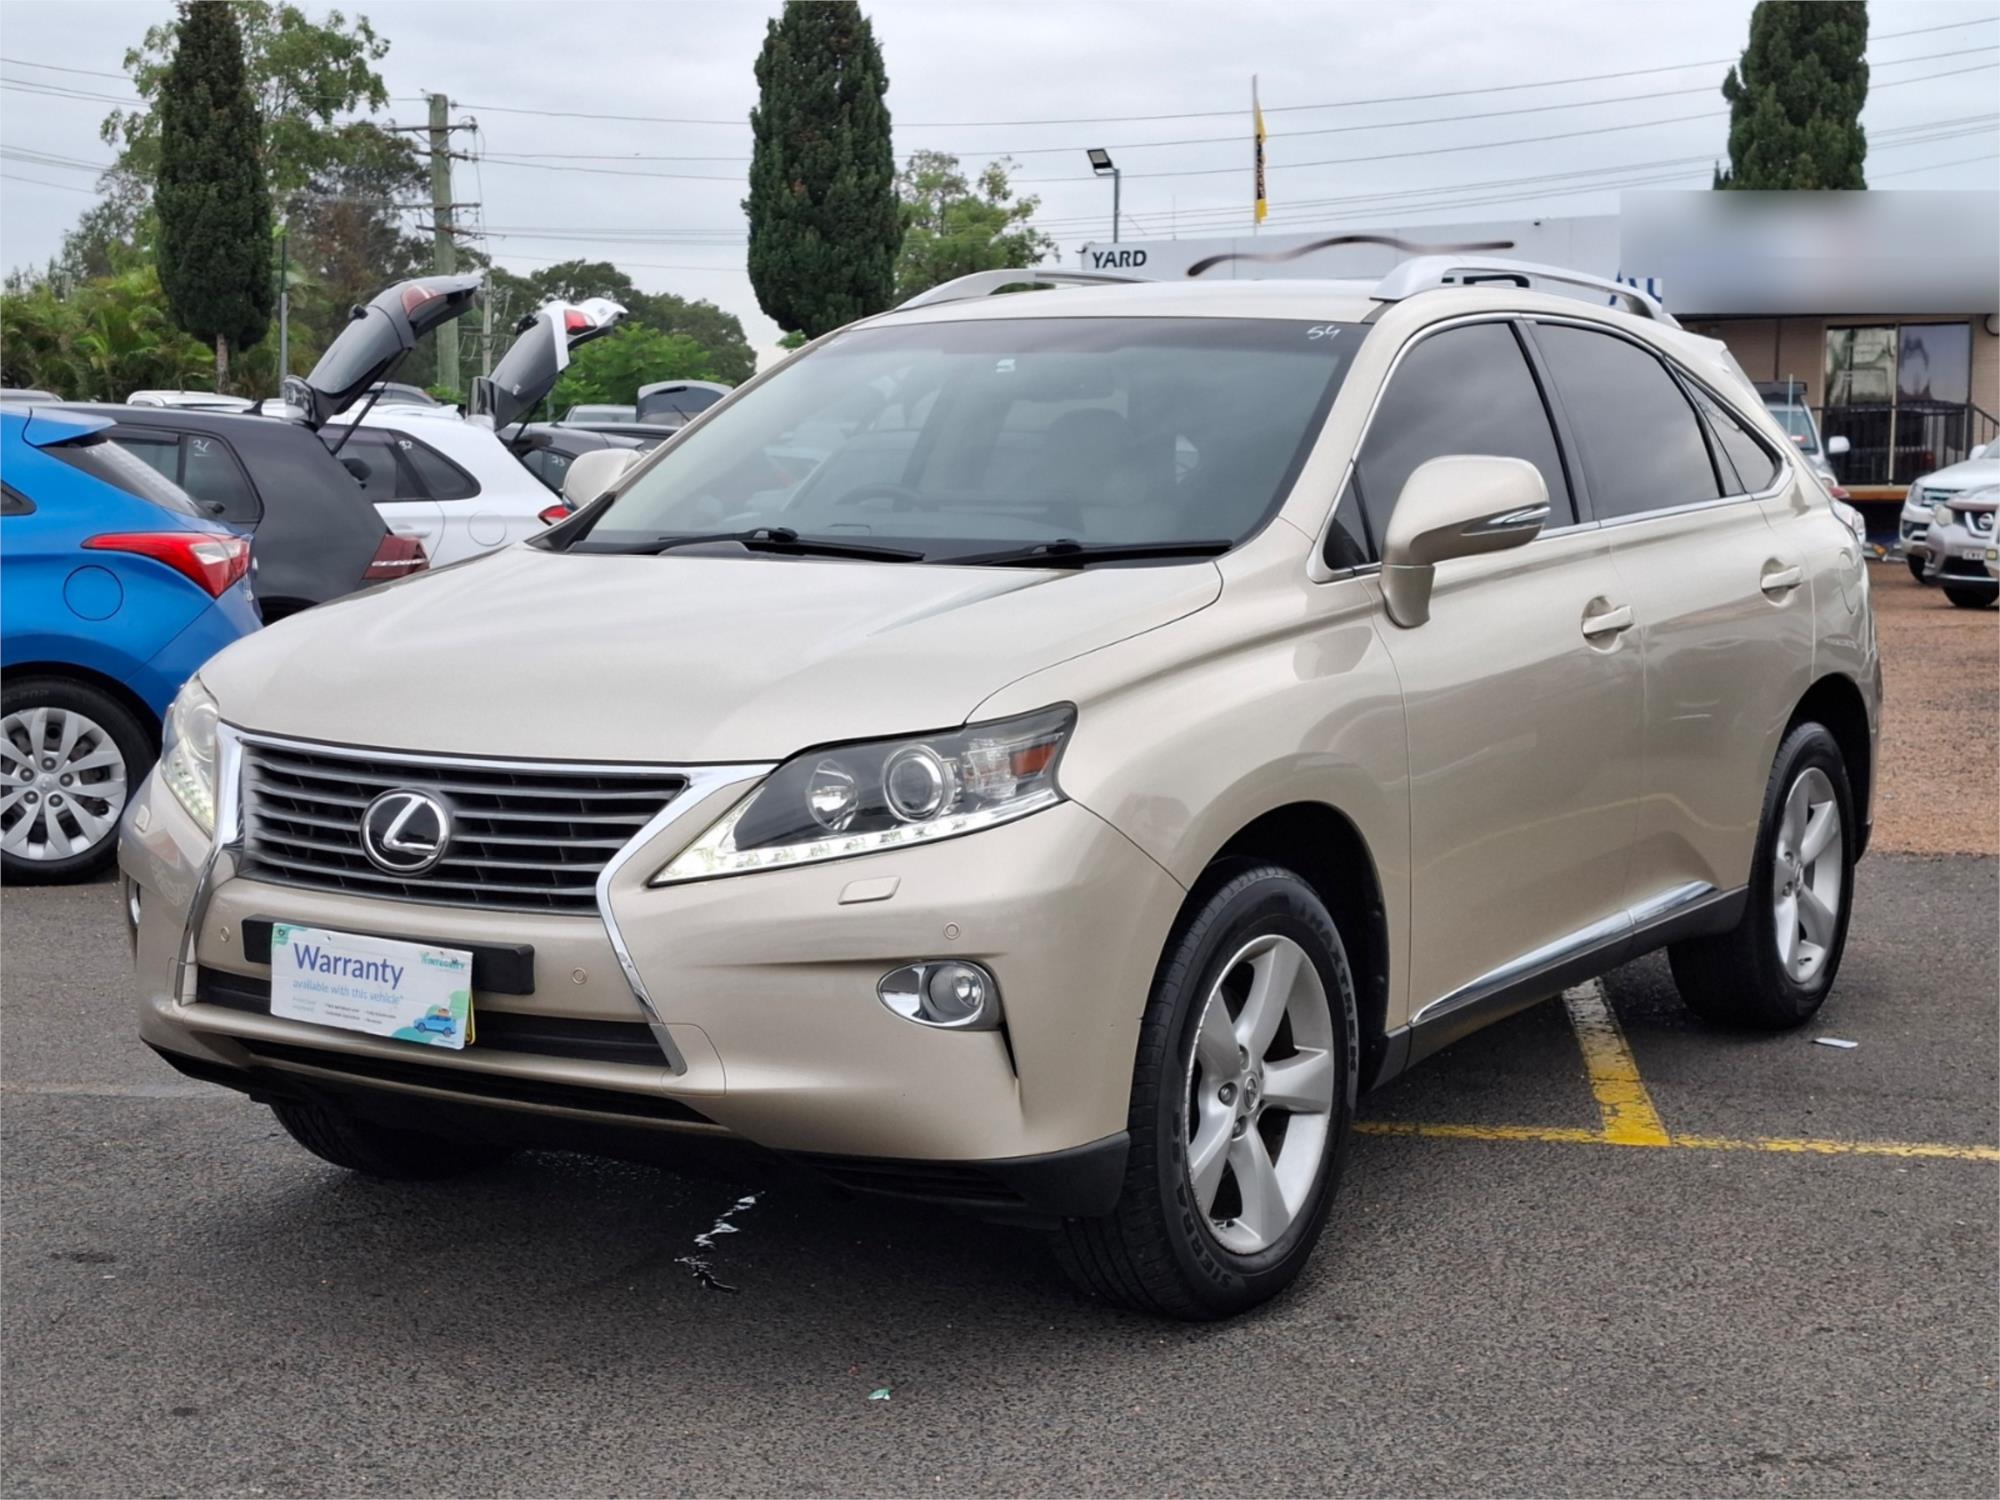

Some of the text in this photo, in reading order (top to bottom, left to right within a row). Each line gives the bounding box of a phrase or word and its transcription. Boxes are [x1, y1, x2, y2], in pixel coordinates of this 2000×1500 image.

[1092, 250, 1147, 268] YARD
[1306, 325, 1341, 340] 54
[293, 942, 404, 990] Warranty
[292, 979, 329, 993] available
[330, 983, 350, 997] with
[351, 987, 368, 1000] this
